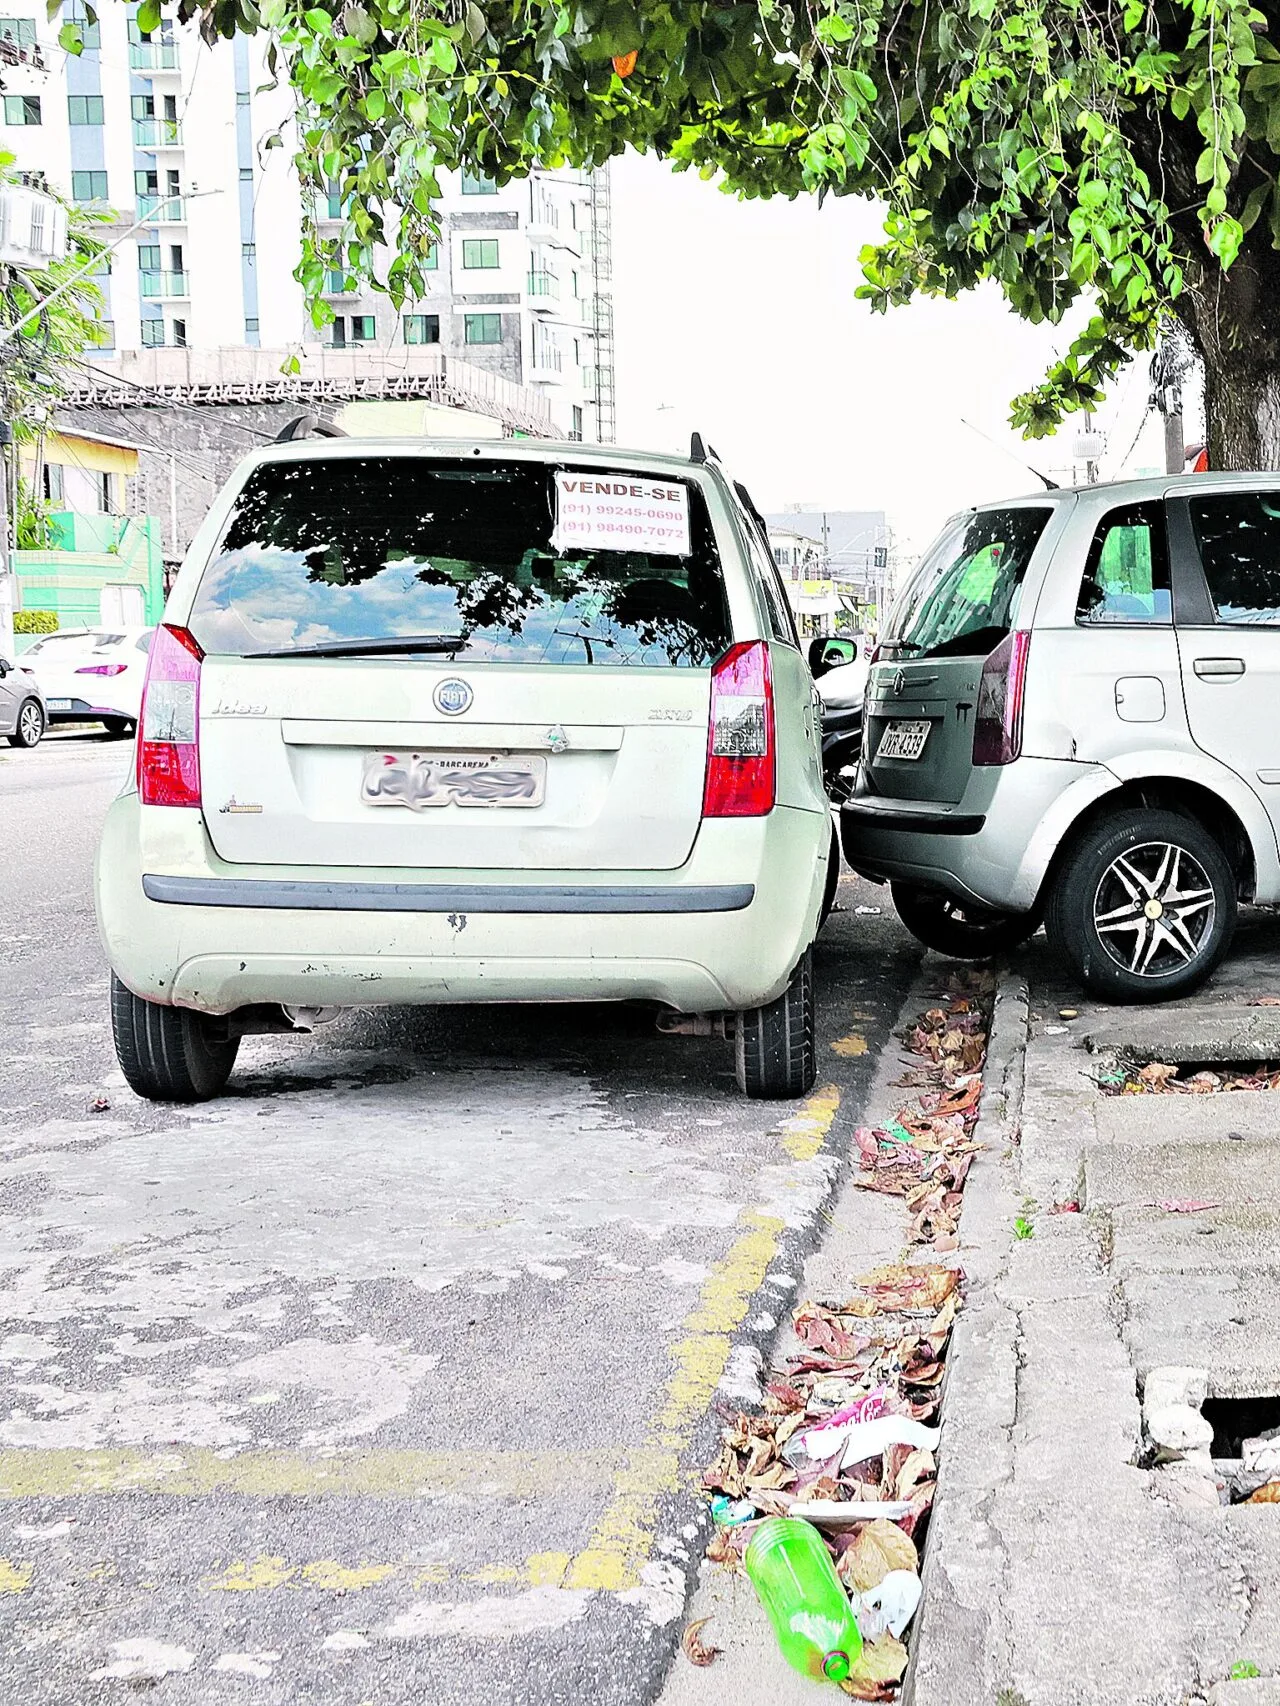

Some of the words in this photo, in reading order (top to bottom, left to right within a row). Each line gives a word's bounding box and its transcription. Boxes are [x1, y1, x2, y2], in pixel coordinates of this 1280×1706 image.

[562, 480, 681, 502] VENDE-SE
[562, 503, 591, 515] (91)
[596, 504, 683, 521] 99245-0690
[562, 521, 592, 533] (91)
[596, 522, 684, 539] 98490-7072
[439, 689, 467, 706] FIAT
